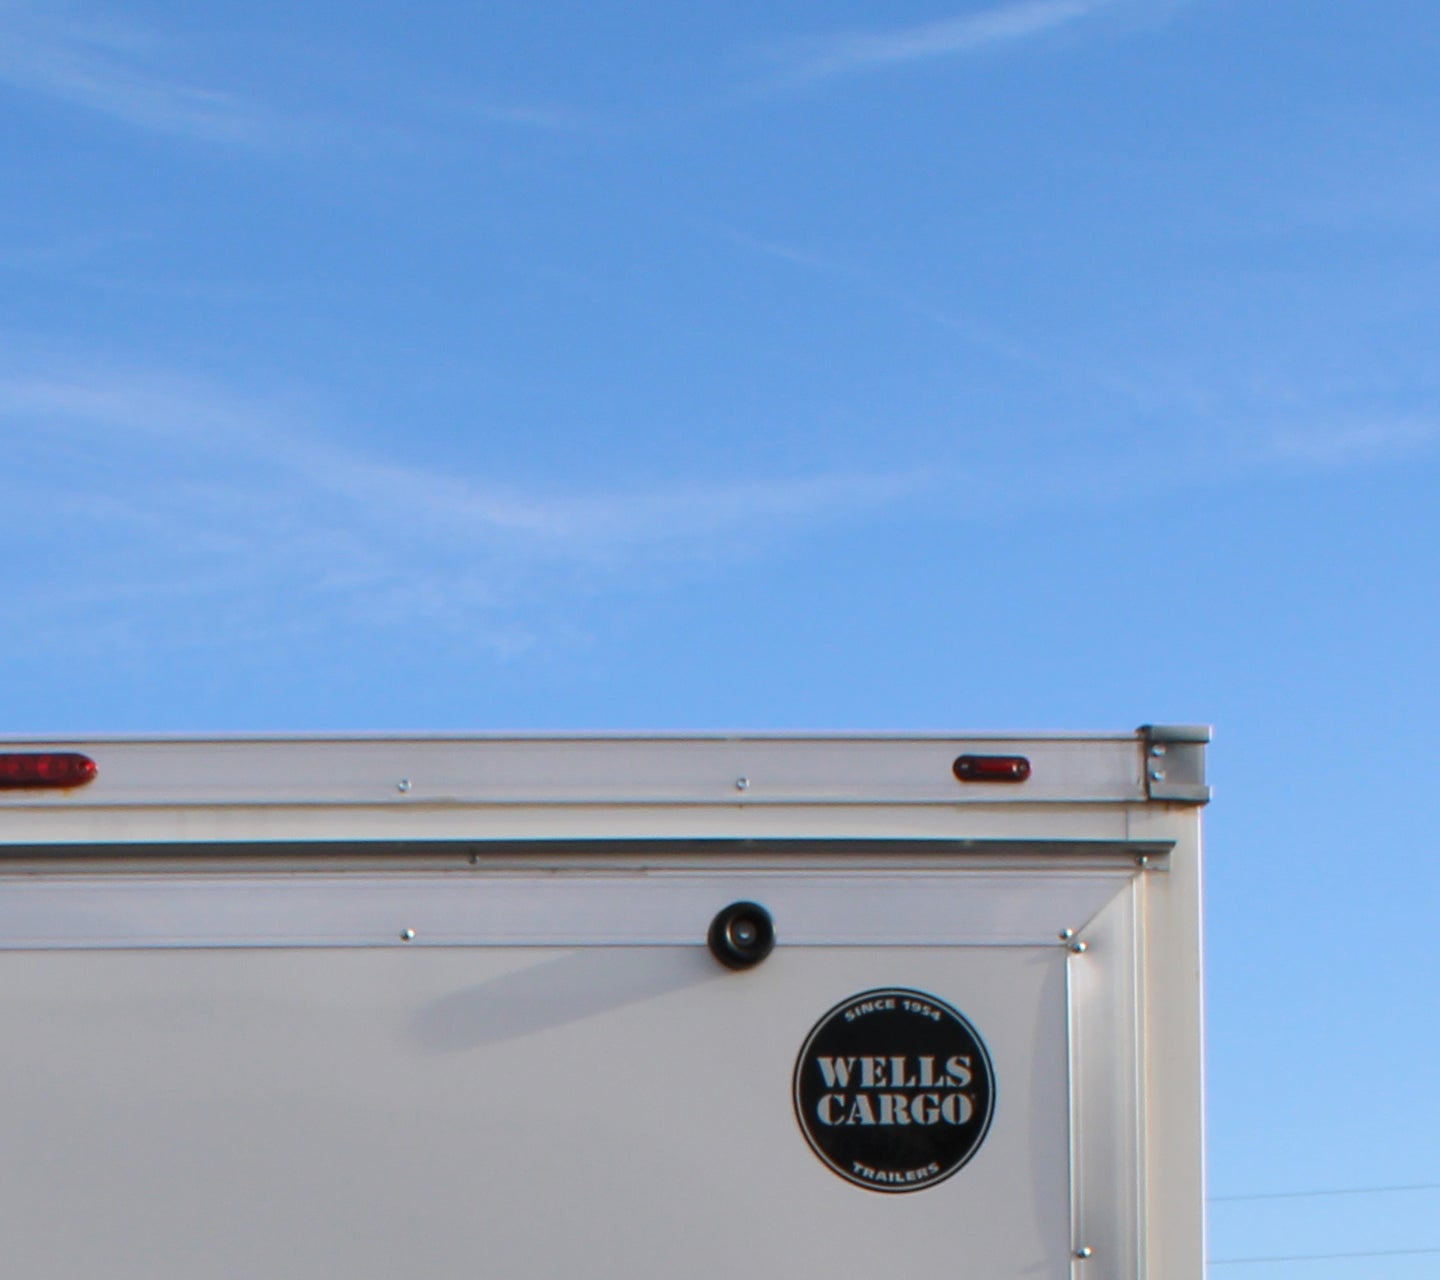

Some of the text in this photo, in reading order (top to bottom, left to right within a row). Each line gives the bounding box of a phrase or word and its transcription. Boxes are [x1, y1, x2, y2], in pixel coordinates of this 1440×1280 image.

[844, 998, 942, 1022] SINCE 1954
[816, 1055, 973, 1088] WELLS
[816, 1093, 974, 1126] CARGO
[852, 1161, 940, 1183] TRAILERS
